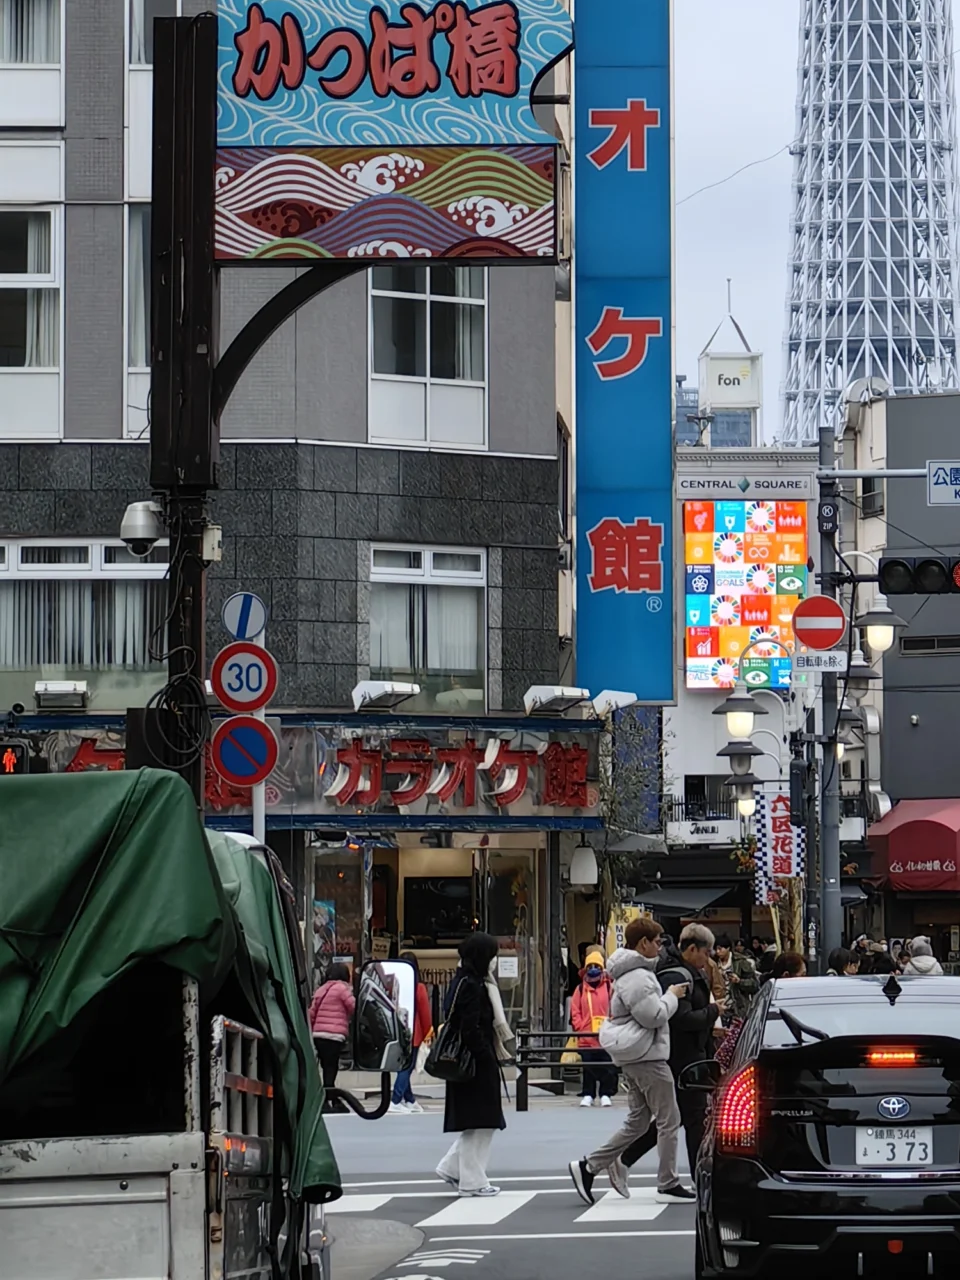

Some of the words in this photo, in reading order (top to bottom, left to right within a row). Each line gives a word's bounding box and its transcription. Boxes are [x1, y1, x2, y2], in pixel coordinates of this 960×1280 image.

[232, 0, 521, 100] かっぱ橋
[717, 373, 741, 387] fon
[680, 479, 736, 489] CENTRAL
[754, 479, 802, 489] SQUARE
[822, 521, 833, 531] ZIP
[715, 578, 745, 588] GOALS
[796, 655, 843, 669] 自転車を除く
[226, 662, 264, 694] 30
[328, 738, 590, 808] カラオケ館
[770, 794, 794, 875] 六区花道
[874, 1128, 895, 1140] 練馬
[897, 1128, 916, 1140] 344
